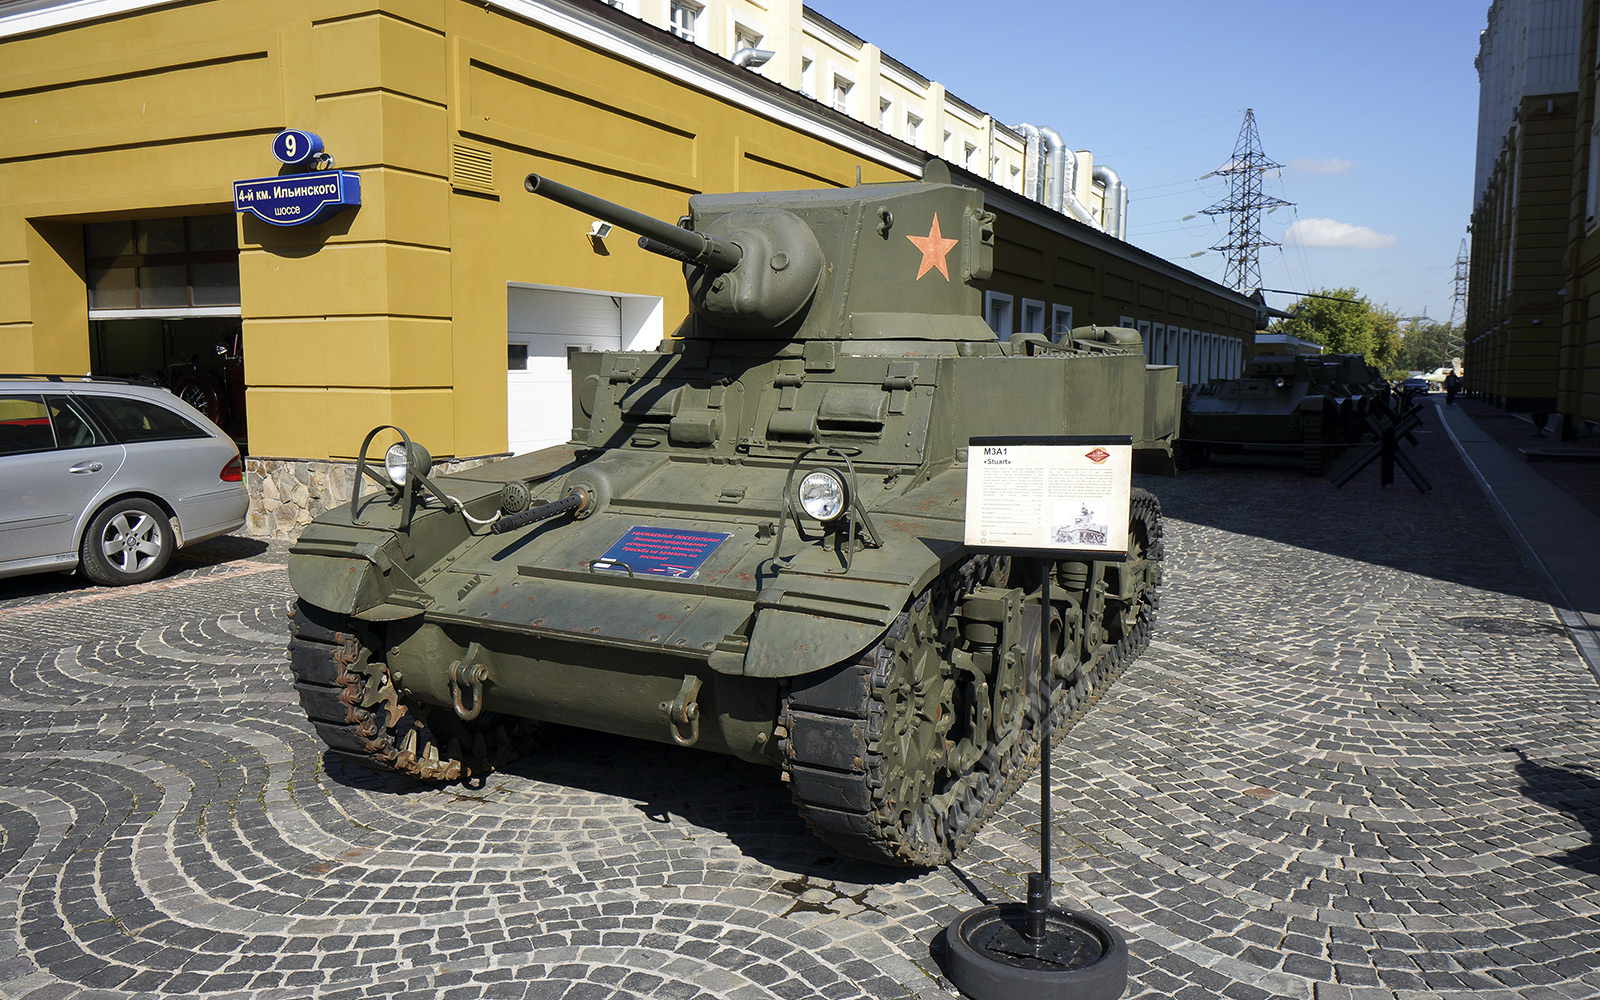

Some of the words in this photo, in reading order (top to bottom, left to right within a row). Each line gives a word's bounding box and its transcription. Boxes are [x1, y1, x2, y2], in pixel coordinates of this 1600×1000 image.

[285, 134, 297, 157] 9
[239, 189, 254, 202] 4-й
[256, 191, 272, 201] км.
[274, 184, 337, 199] Ильинского
[274, 205, 301, 216] шоссе
[984, 447, 1007, 456] M3A1
[631, 531, 674, 539] УВАЖАЕМЫЕ
